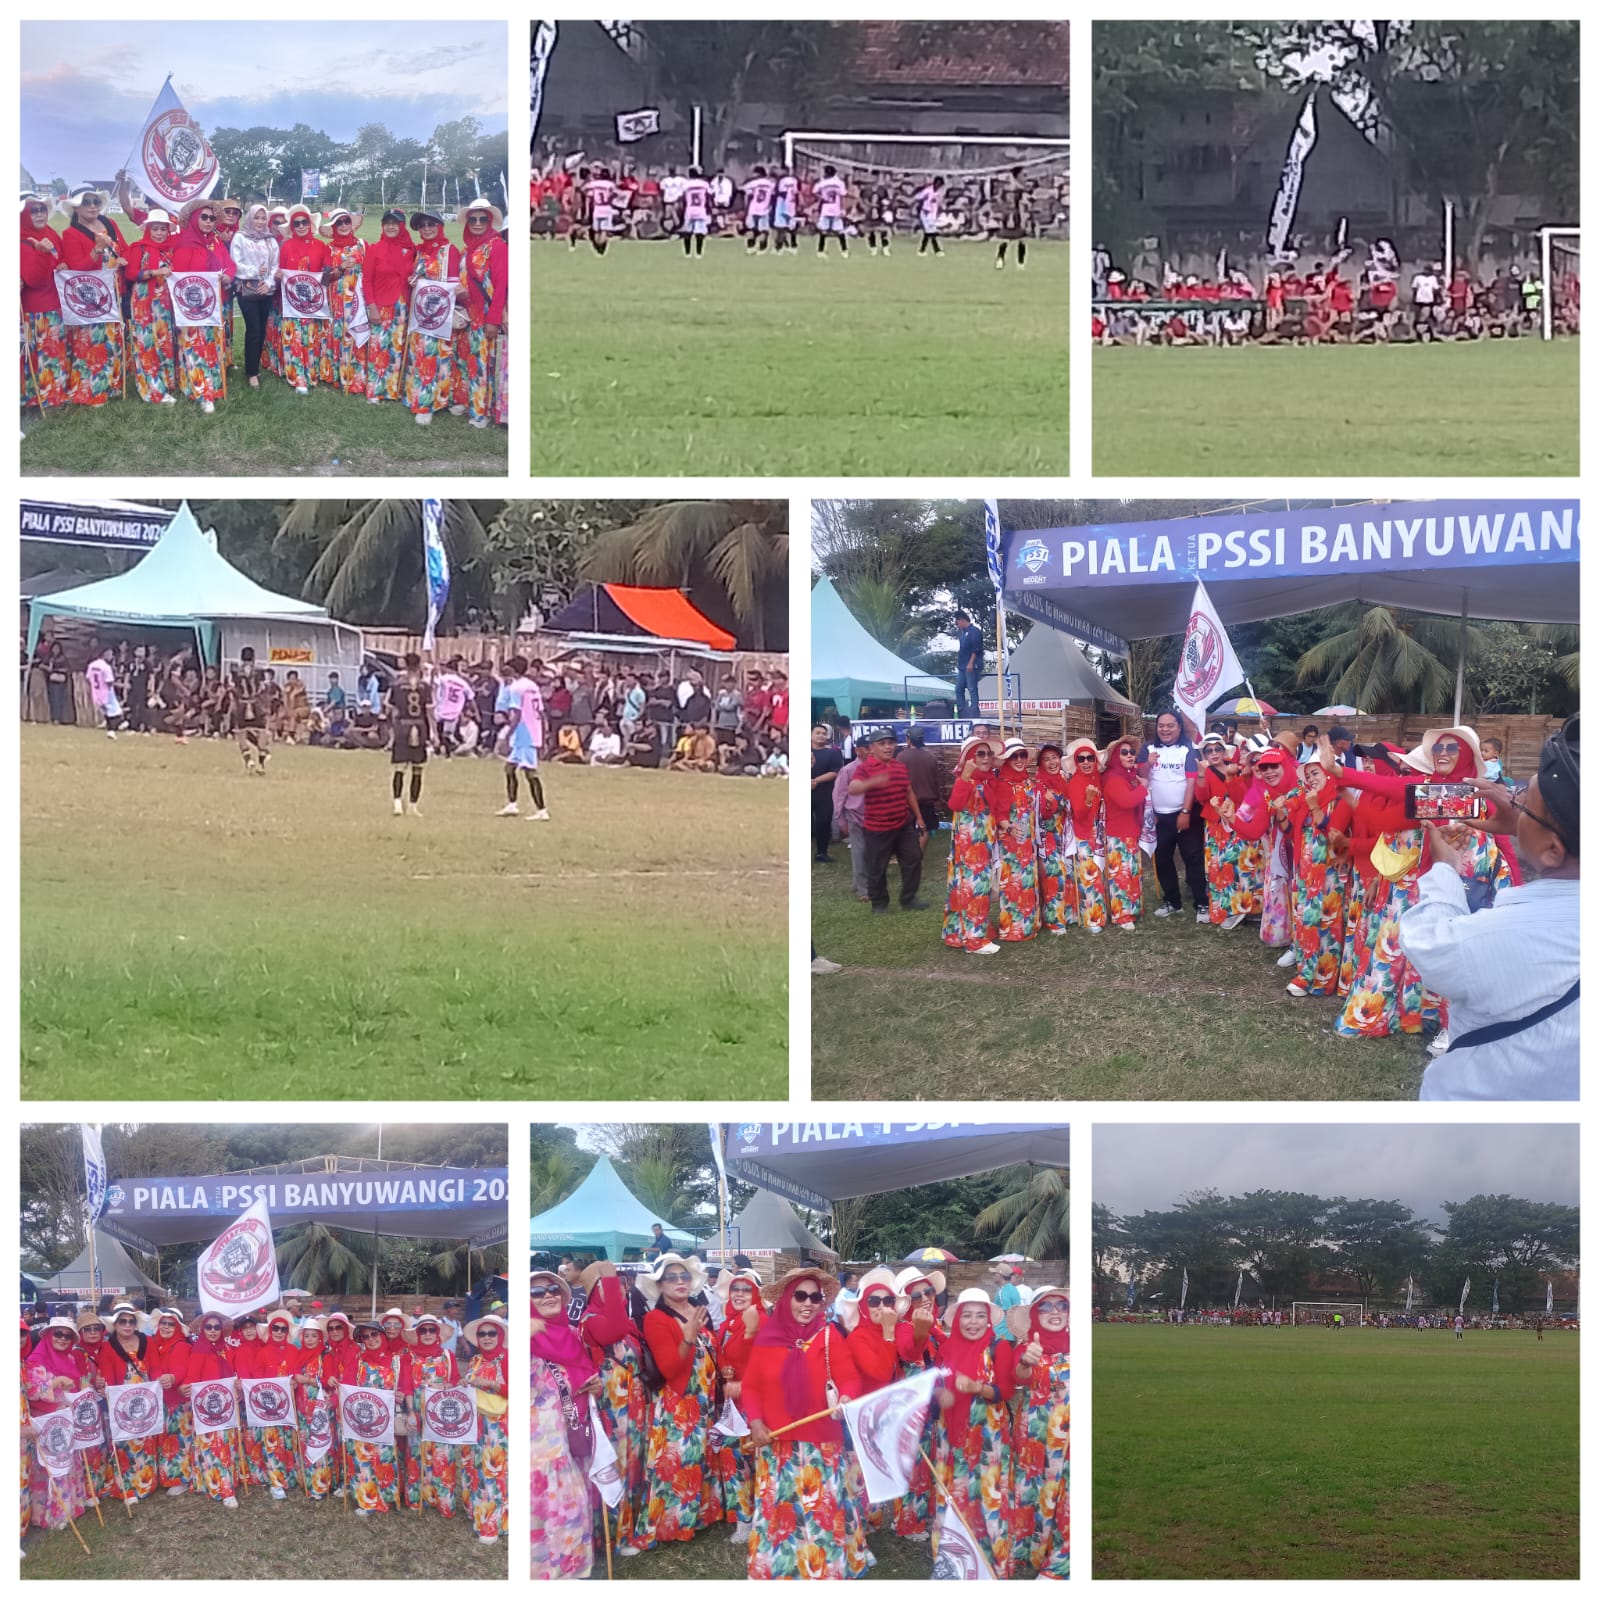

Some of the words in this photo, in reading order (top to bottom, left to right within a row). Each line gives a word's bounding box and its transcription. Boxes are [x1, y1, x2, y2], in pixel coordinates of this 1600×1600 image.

[52, 515, 75, 533] PSSI
[1062, 535, 1177, 576] PIALA
[1187, 534, 1197, 570] KETUA
[1198, 528, 1285, 569] PSSI
[1300, 508, 1580, 564] BANYUWAN
[407, 691, 420, 716] 8
[1039, 700, 1062, 710] KULON
[133, 1185, 209, 1210] PIALA
[222, 1185, 276, 1209] PSSI
[284, 1178, 465, 1208] BANYUWANGI
